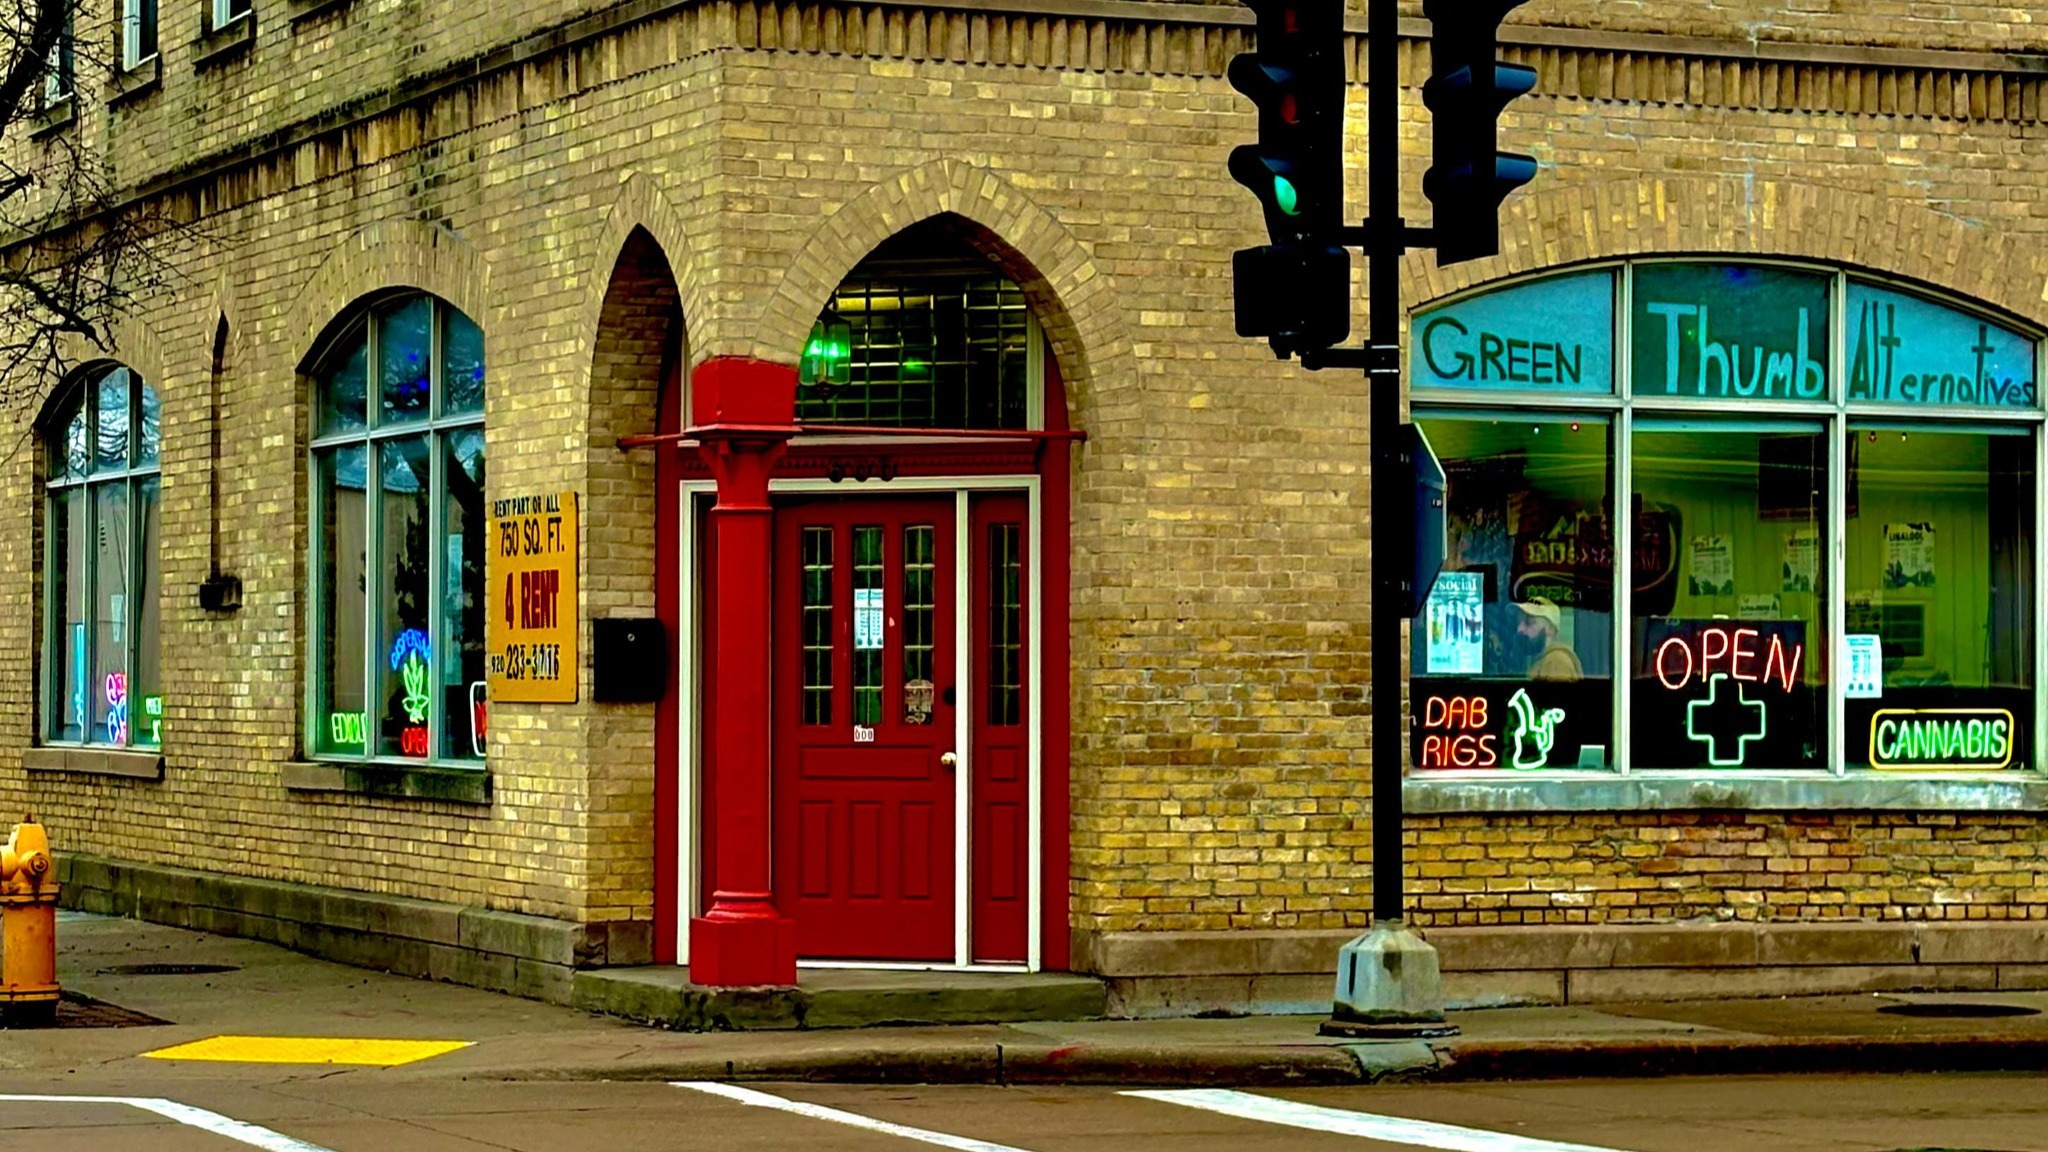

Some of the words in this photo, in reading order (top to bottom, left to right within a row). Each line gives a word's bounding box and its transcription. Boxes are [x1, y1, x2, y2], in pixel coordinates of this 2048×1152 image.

[1421, 315, 1582, 386] GREEN
[1646, 301, 1825, 398] Thumb
[1848, 299, 2035, 408] Alternatives
[494, 498, 511, 518] RENT
[512, 496, 530, 516] PART
[532, 495, 542, 514] OR
[546, 494, 560, 513] ALL
[500, 520, 519, 557] 750
[523, 517, 543, 556] SQ.
[547, 516, 565, 553] FT.
[505, 571, 515, 630] 4
[520, 569, 560, 630] RENT
[491, 654, 505, 673] 920
[1656, 627, 1802, 694] OPEN
[1424, 695, 1489, 729] DAB
[1422, 734, 1497, 767] RIGS
[1877, 718, 2007, 760] CANNABIS
